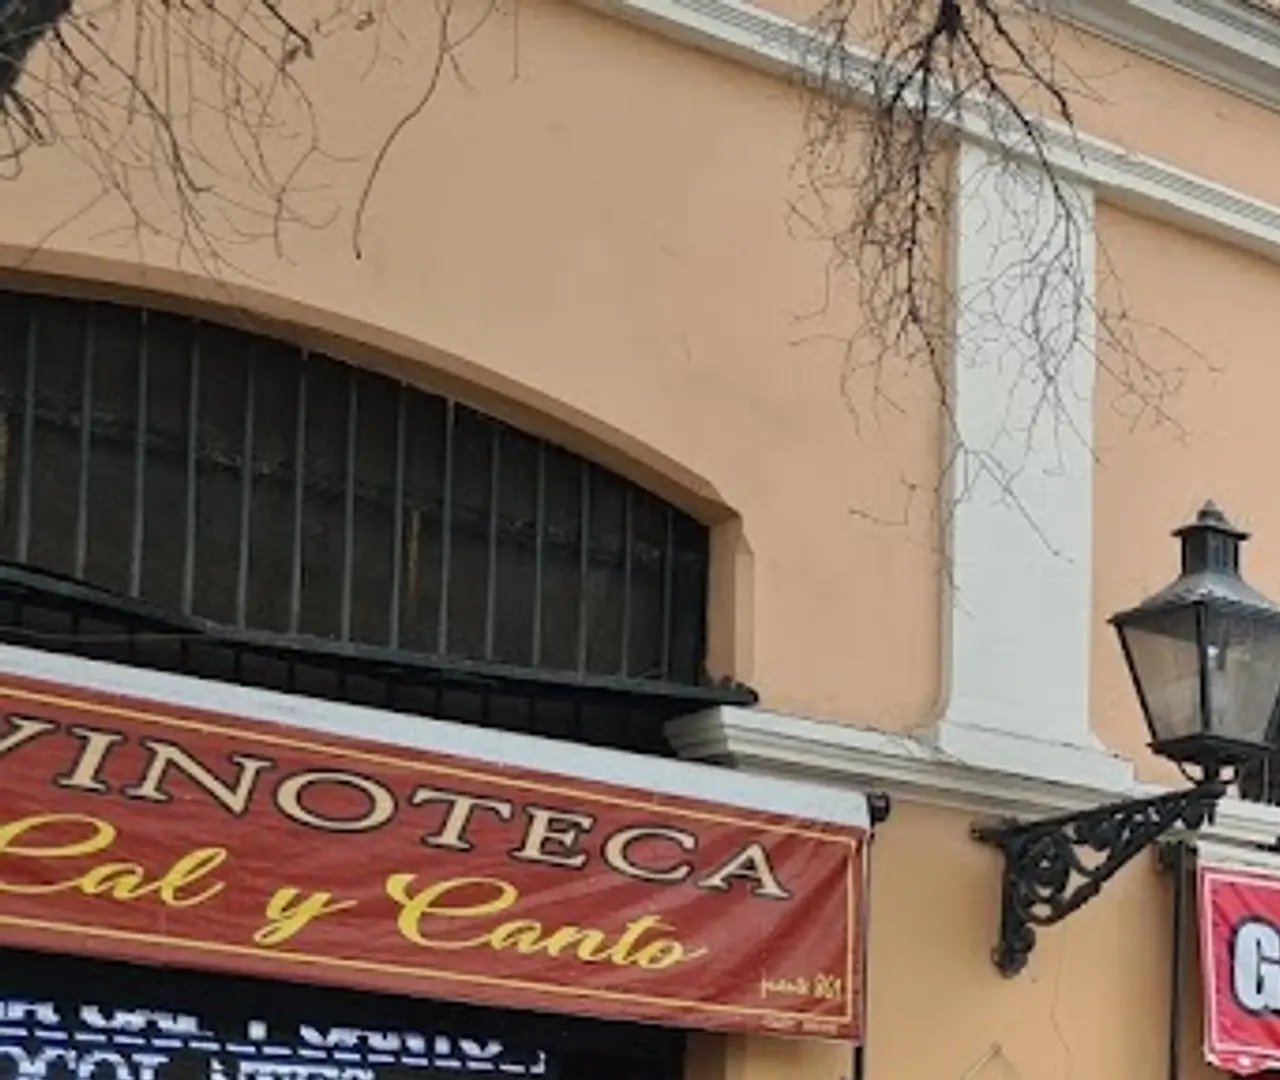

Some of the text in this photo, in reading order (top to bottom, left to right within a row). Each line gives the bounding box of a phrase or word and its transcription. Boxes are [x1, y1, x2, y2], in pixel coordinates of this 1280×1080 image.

[0, 813, 708, 973] Cal y Canto
